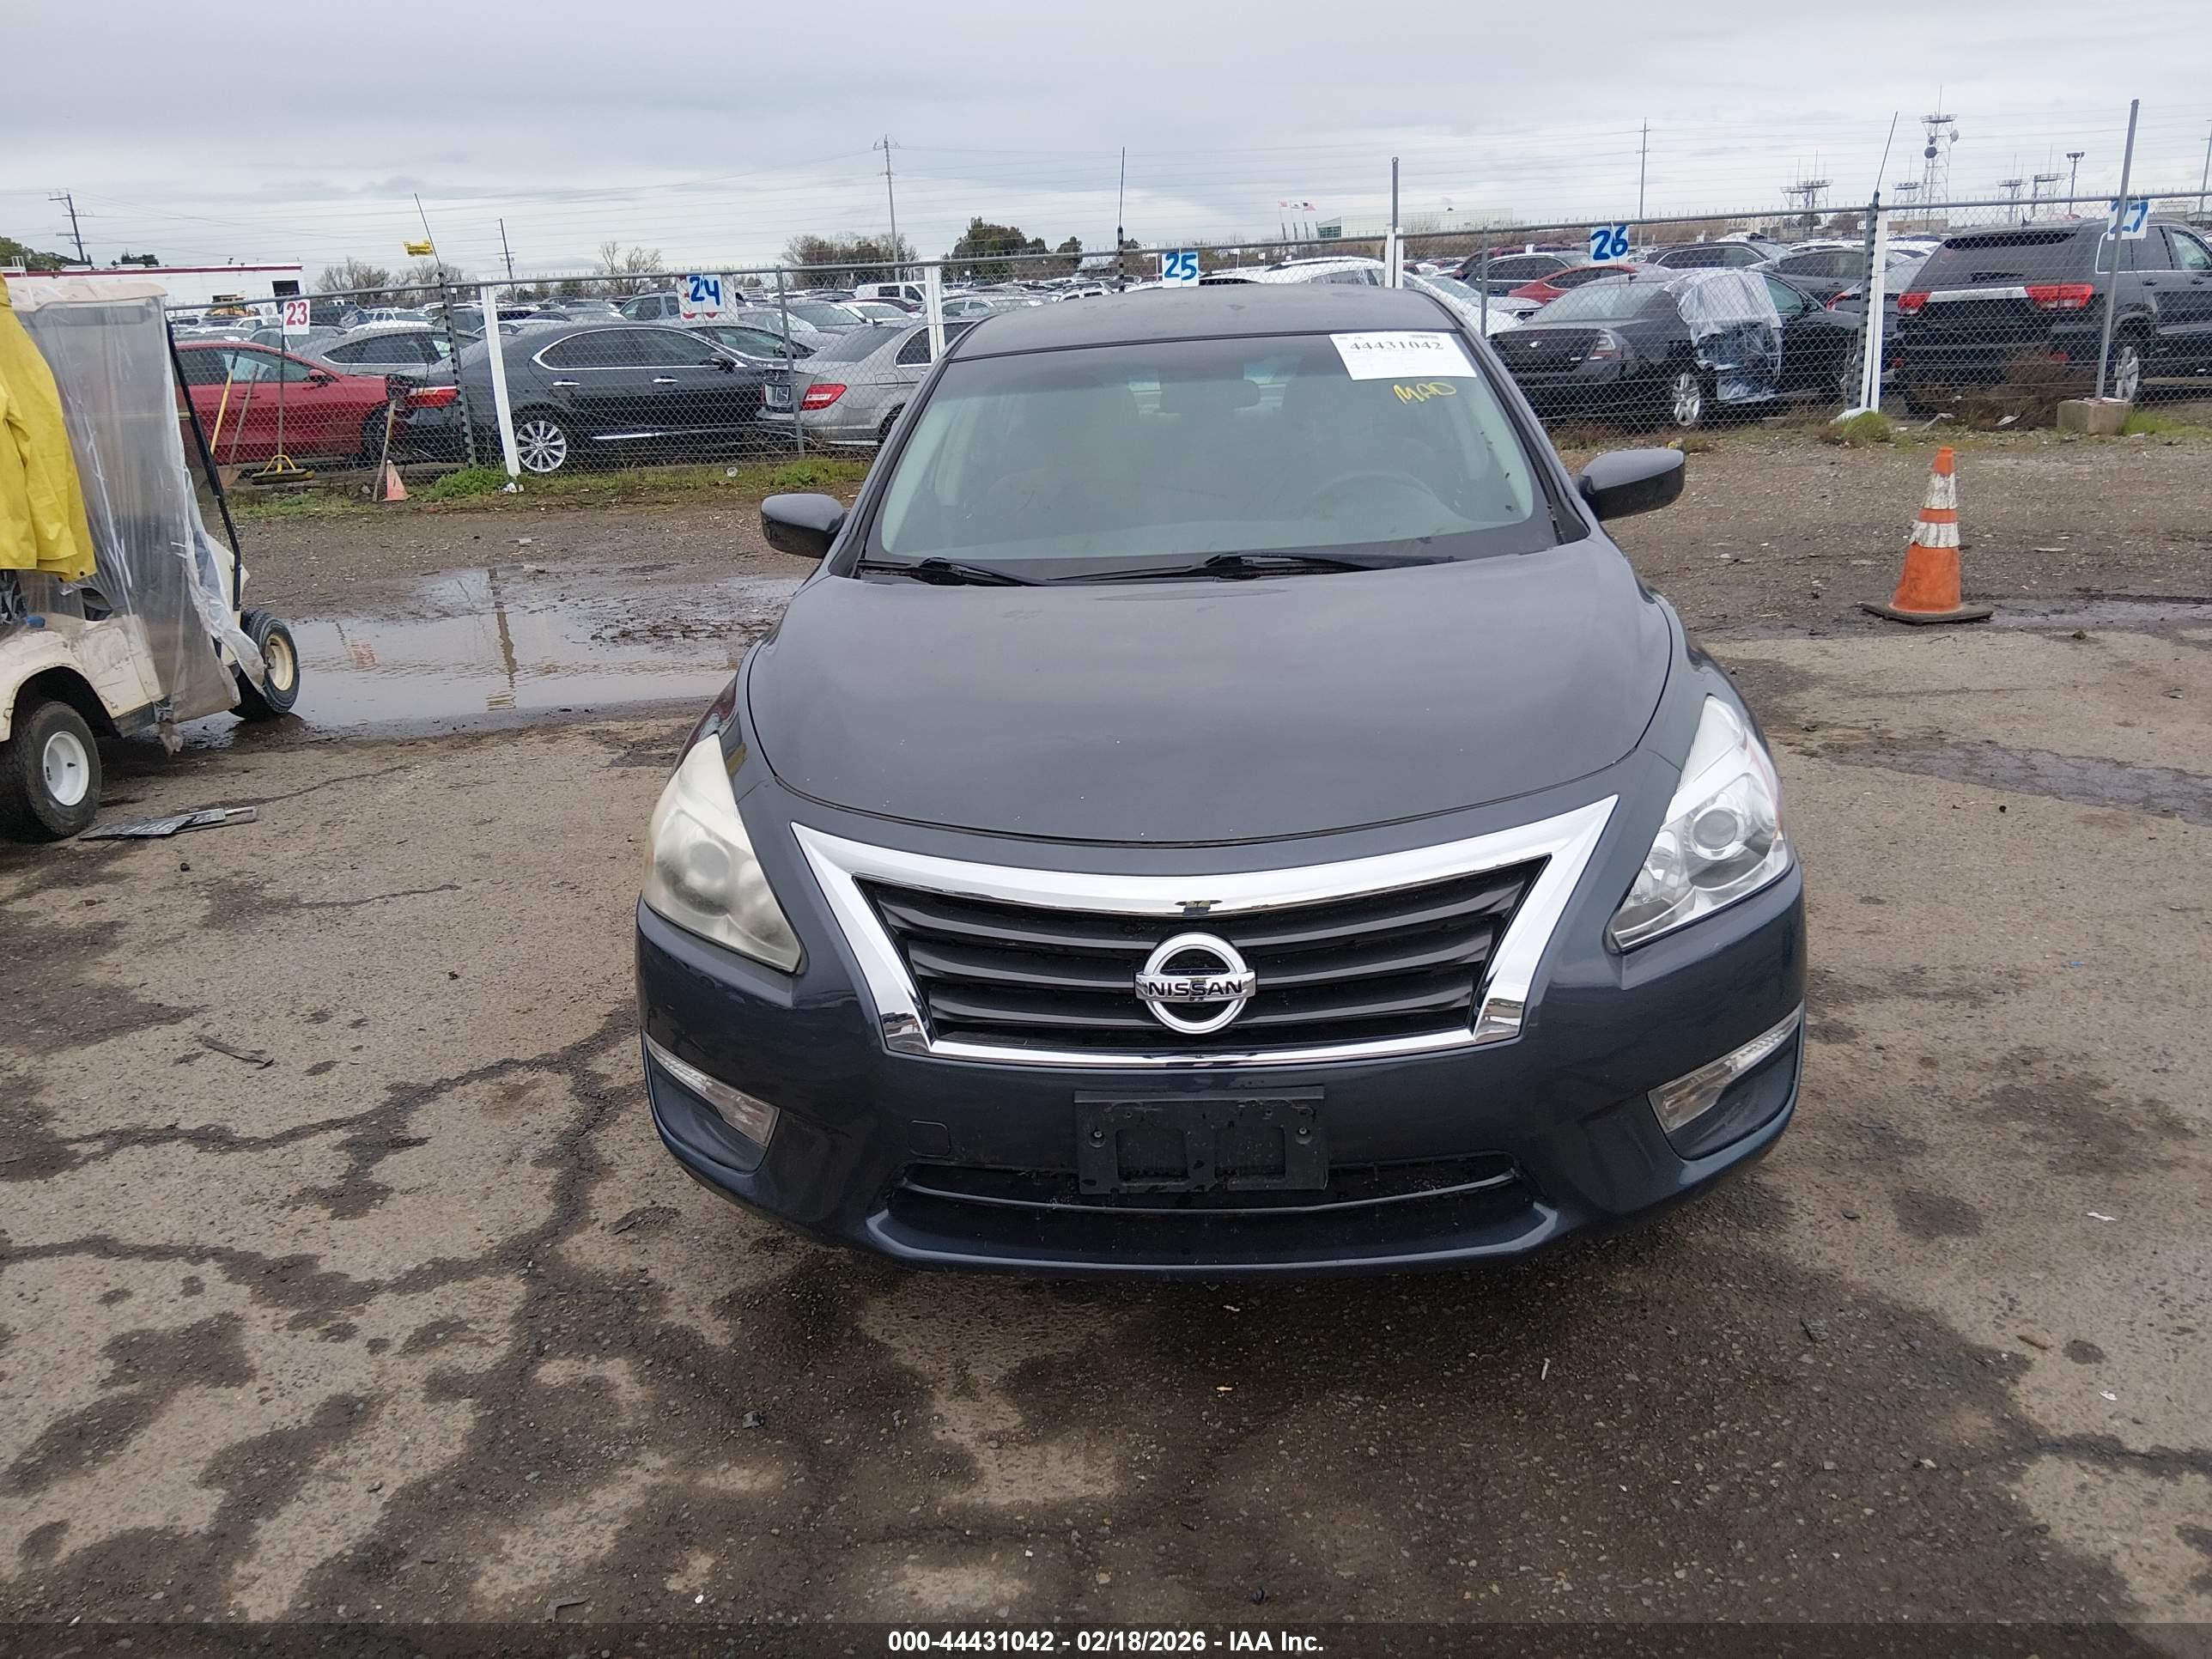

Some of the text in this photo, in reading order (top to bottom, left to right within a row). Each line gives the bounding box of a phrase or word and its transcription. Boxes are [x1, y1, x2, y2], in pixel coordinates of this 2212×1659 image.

[1590, 226, 1628, 260] 26
[1164, 252, 1197, 281] 25
[690, 276, 720, 307] 24
[286, 301, 308, 325] 23
[1350, 341, 1444, 350] 44431042
[1148, 979, 1243, 997] NISSAN
